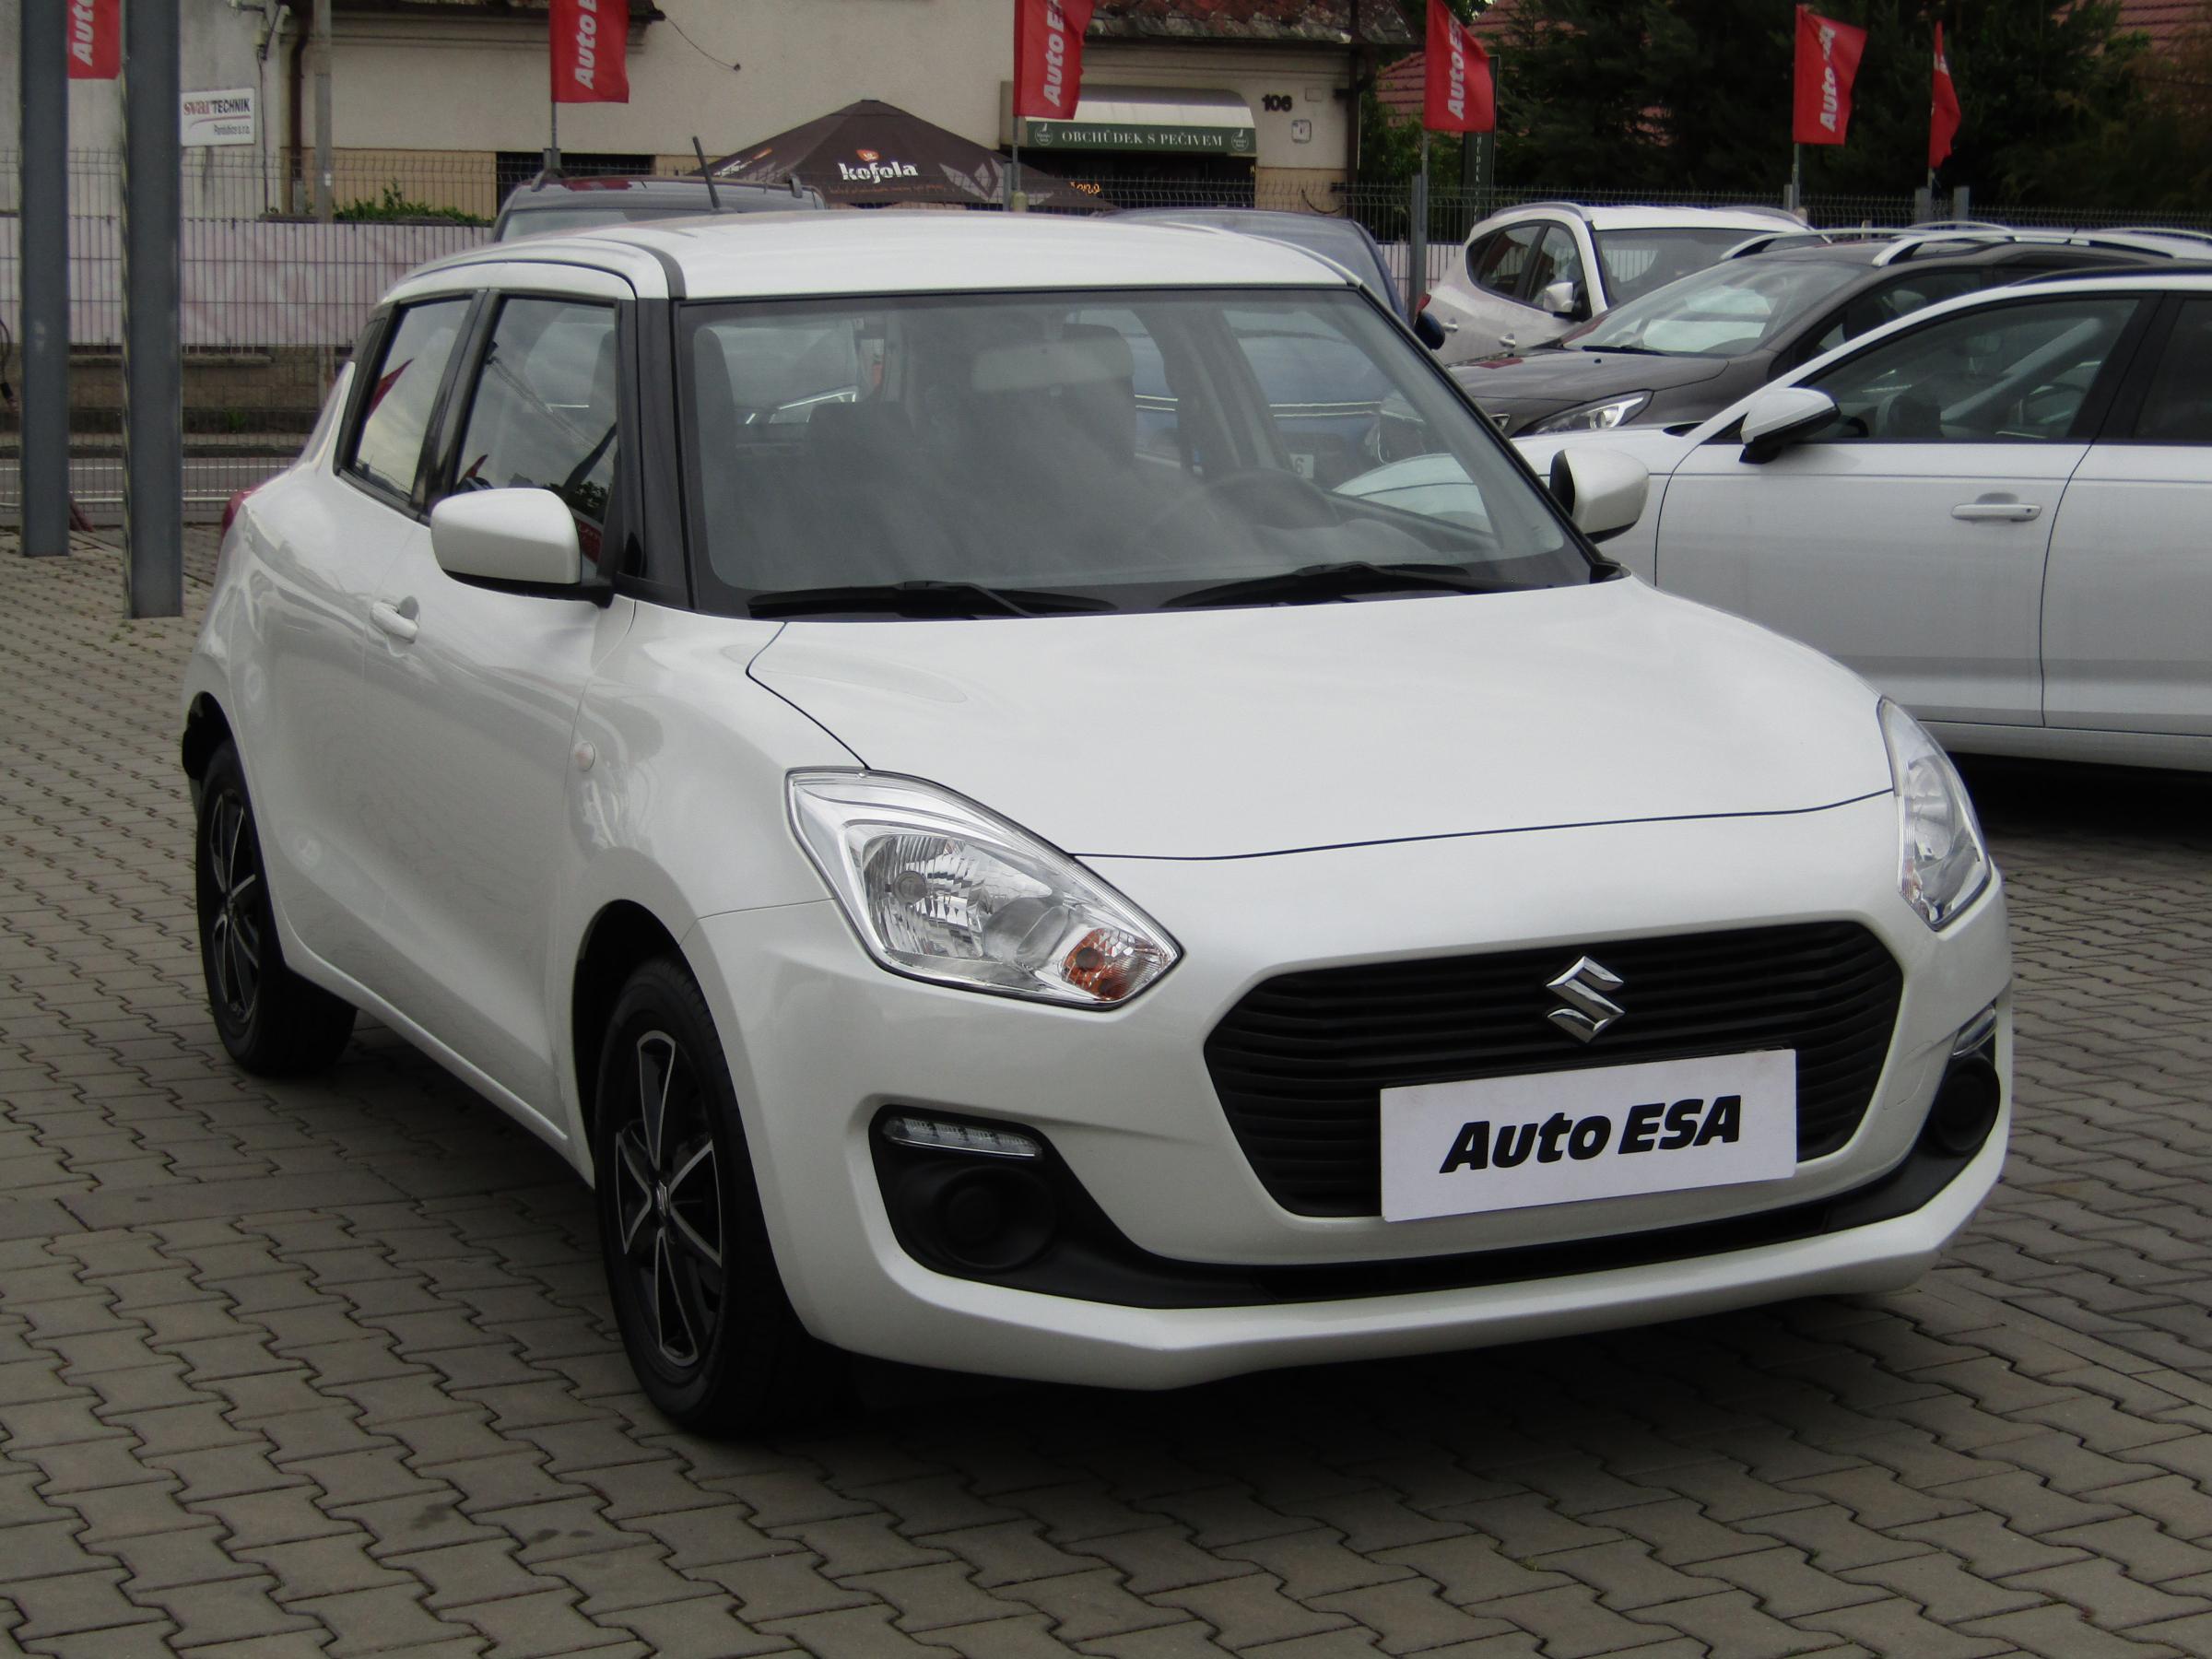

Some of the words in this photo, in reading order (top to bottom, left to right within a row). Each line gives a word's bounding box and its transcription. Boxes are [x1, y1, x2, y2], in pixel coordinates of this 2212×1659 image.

[1262, 95, 1292, 112] 106
[1062, 129, 1143, 145] OBCHŮDEK
[1147, 132, 1156, 145] S
[1160, 131, 1222, 147] PEČIVEM
[838, 160, 918, 183] kofola
